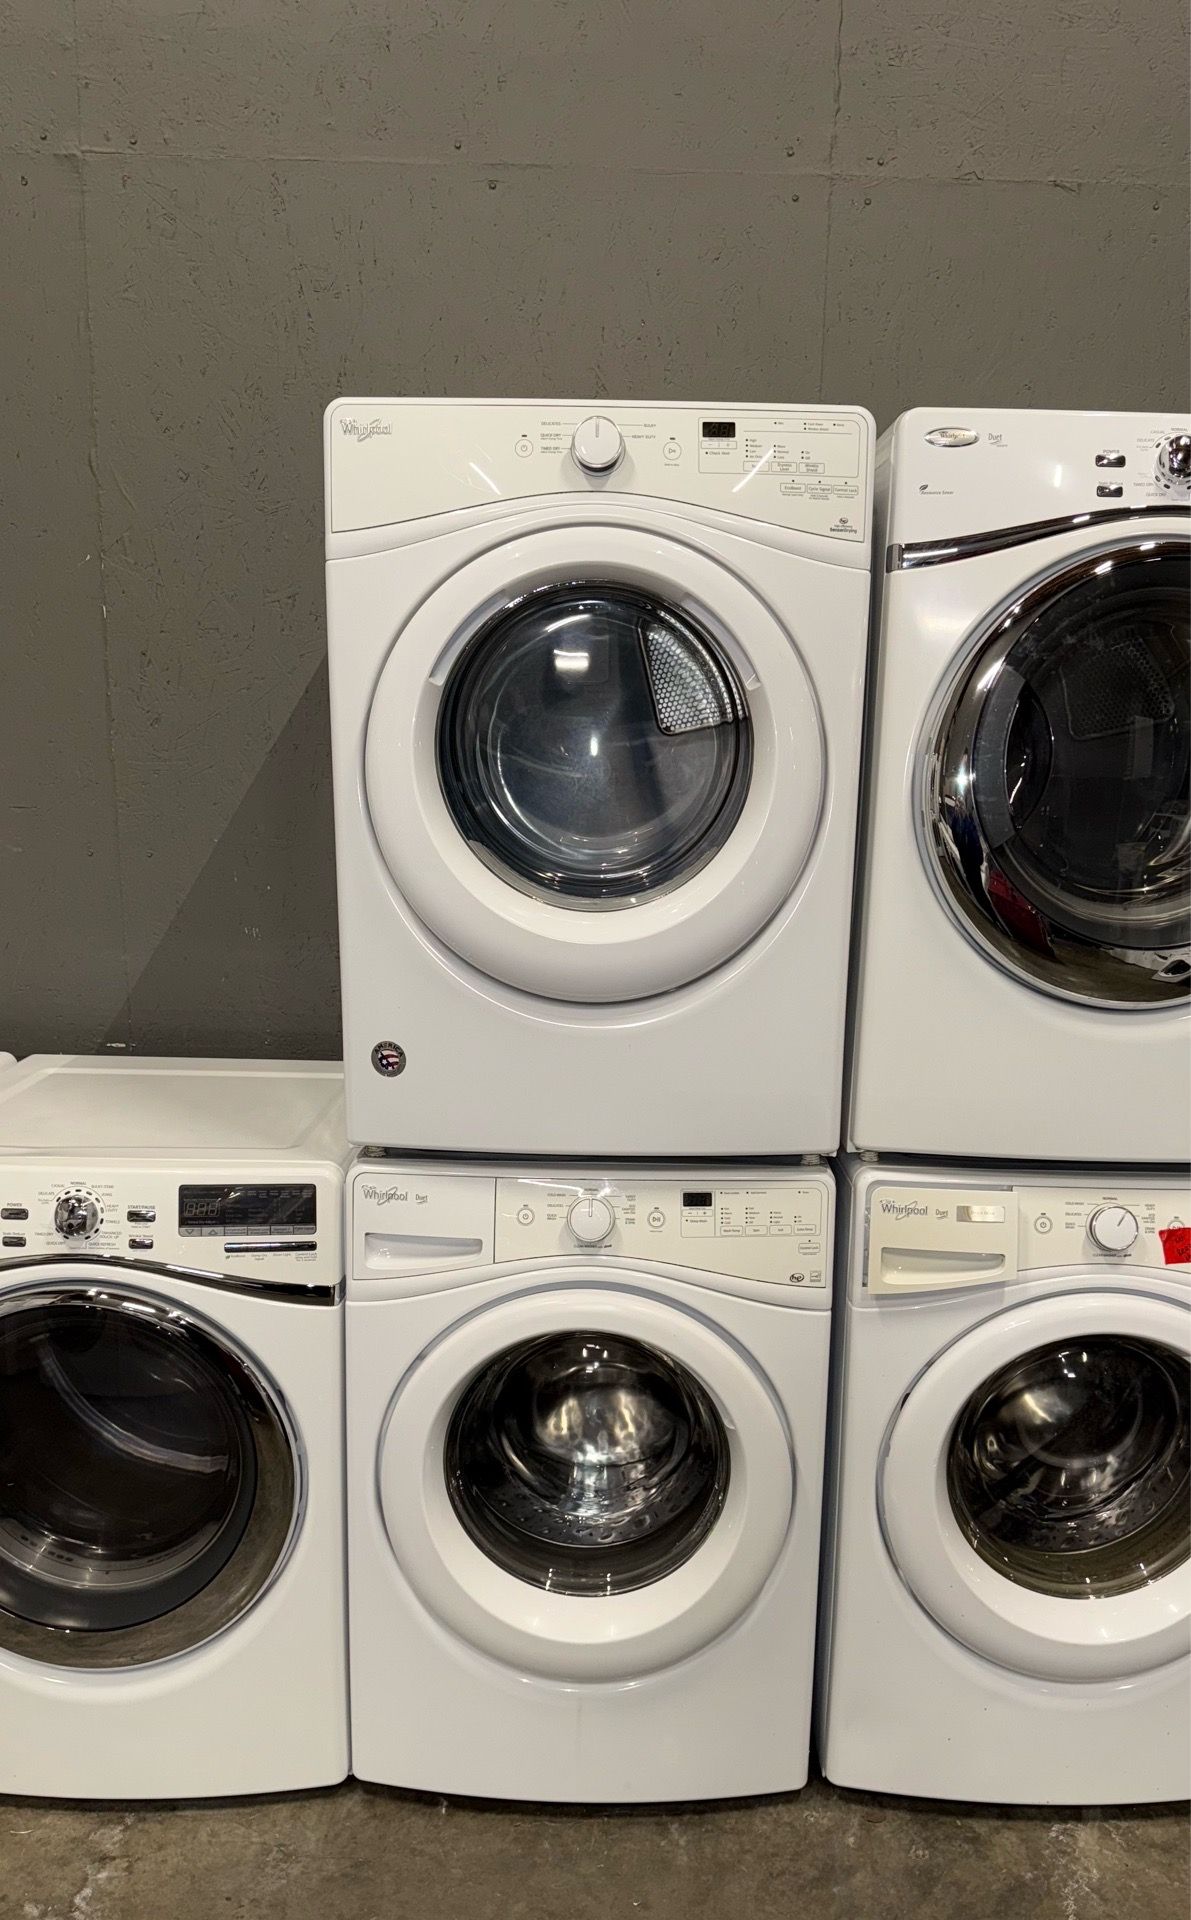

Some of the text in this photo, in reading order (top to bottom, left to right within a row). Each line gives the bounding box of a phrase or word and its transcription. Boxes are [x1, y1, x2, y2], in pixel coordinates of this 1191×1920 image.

[988, 432, 1003, 441] Duet
[362, 1188, 408, 1204] Whirlpool
[881, 1202, 948, 1219] Whirlpool Duet
